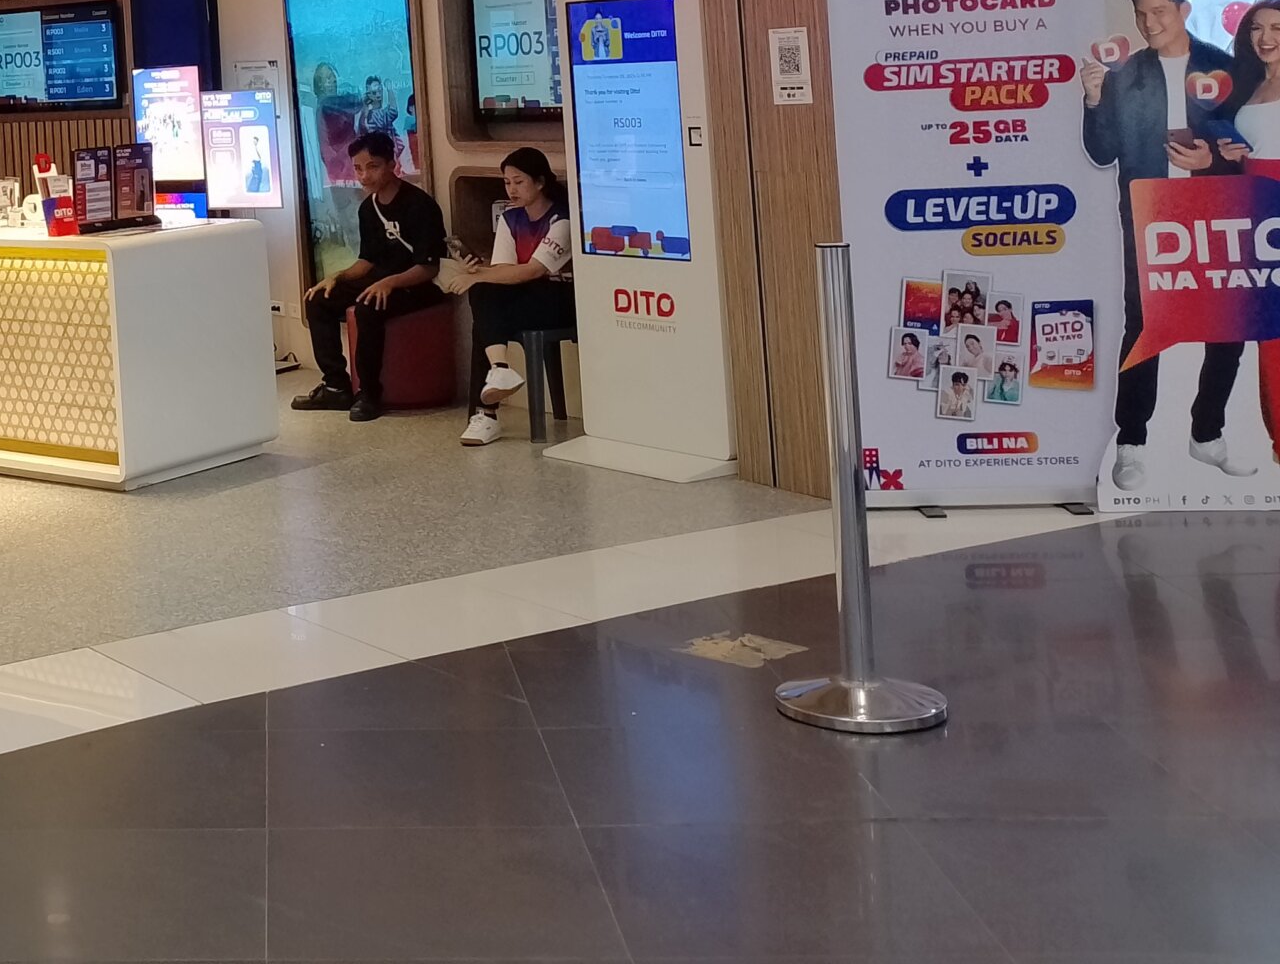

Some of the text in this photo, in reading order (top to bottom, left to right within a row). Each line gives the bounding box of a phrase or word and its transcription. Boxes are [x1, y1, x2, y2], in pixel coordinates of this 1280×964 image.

[101, 24, 106, 32] 3
[889, 18, 1048, 38] WHEN YOU BUY A
[624, 31, 651, 39] Welcome
[103, 44, 108, 52] 3
[478, 31, 545, 58] RP003
[884, 50, 939, 62] PREPAID
[104, 64, 109, 72] 3
[883, 58, 1060, 87] SIM STARTER
[495, 75, 518, 83] Counter
[105, 84, 110, 92] 3
[964, 84, 1034, 107] PACK
[613, 117, 642, 129] RS003
[921, 123, 934, 131] UP
[949, 120, 993, 145] 25
[993, 119, 1027, 134] GB
[995, 135, 1029, 143] DATA
[54, 208, 73, 217] DITO
[905, 189, 1060, 224] LEVEL-UP
[971, 229, 1058, 247] SOCIALS
[1145, 217, 1280, 265] DITO
[542, 238, 564, 255] DITO
[1148, 270, 1198, 291] NA
[614, 289, 675, 317] DITO
[616, 320, 677, 334] TELECOMMUNITY
[1041, 320, 1084, 336] DITO
[966, 437, 1028, 450] BILI NA
[918, 455, 1079, 468] AT DITO EXPERIENCE STORES
[1113, 497, 1141, 505] DITO
